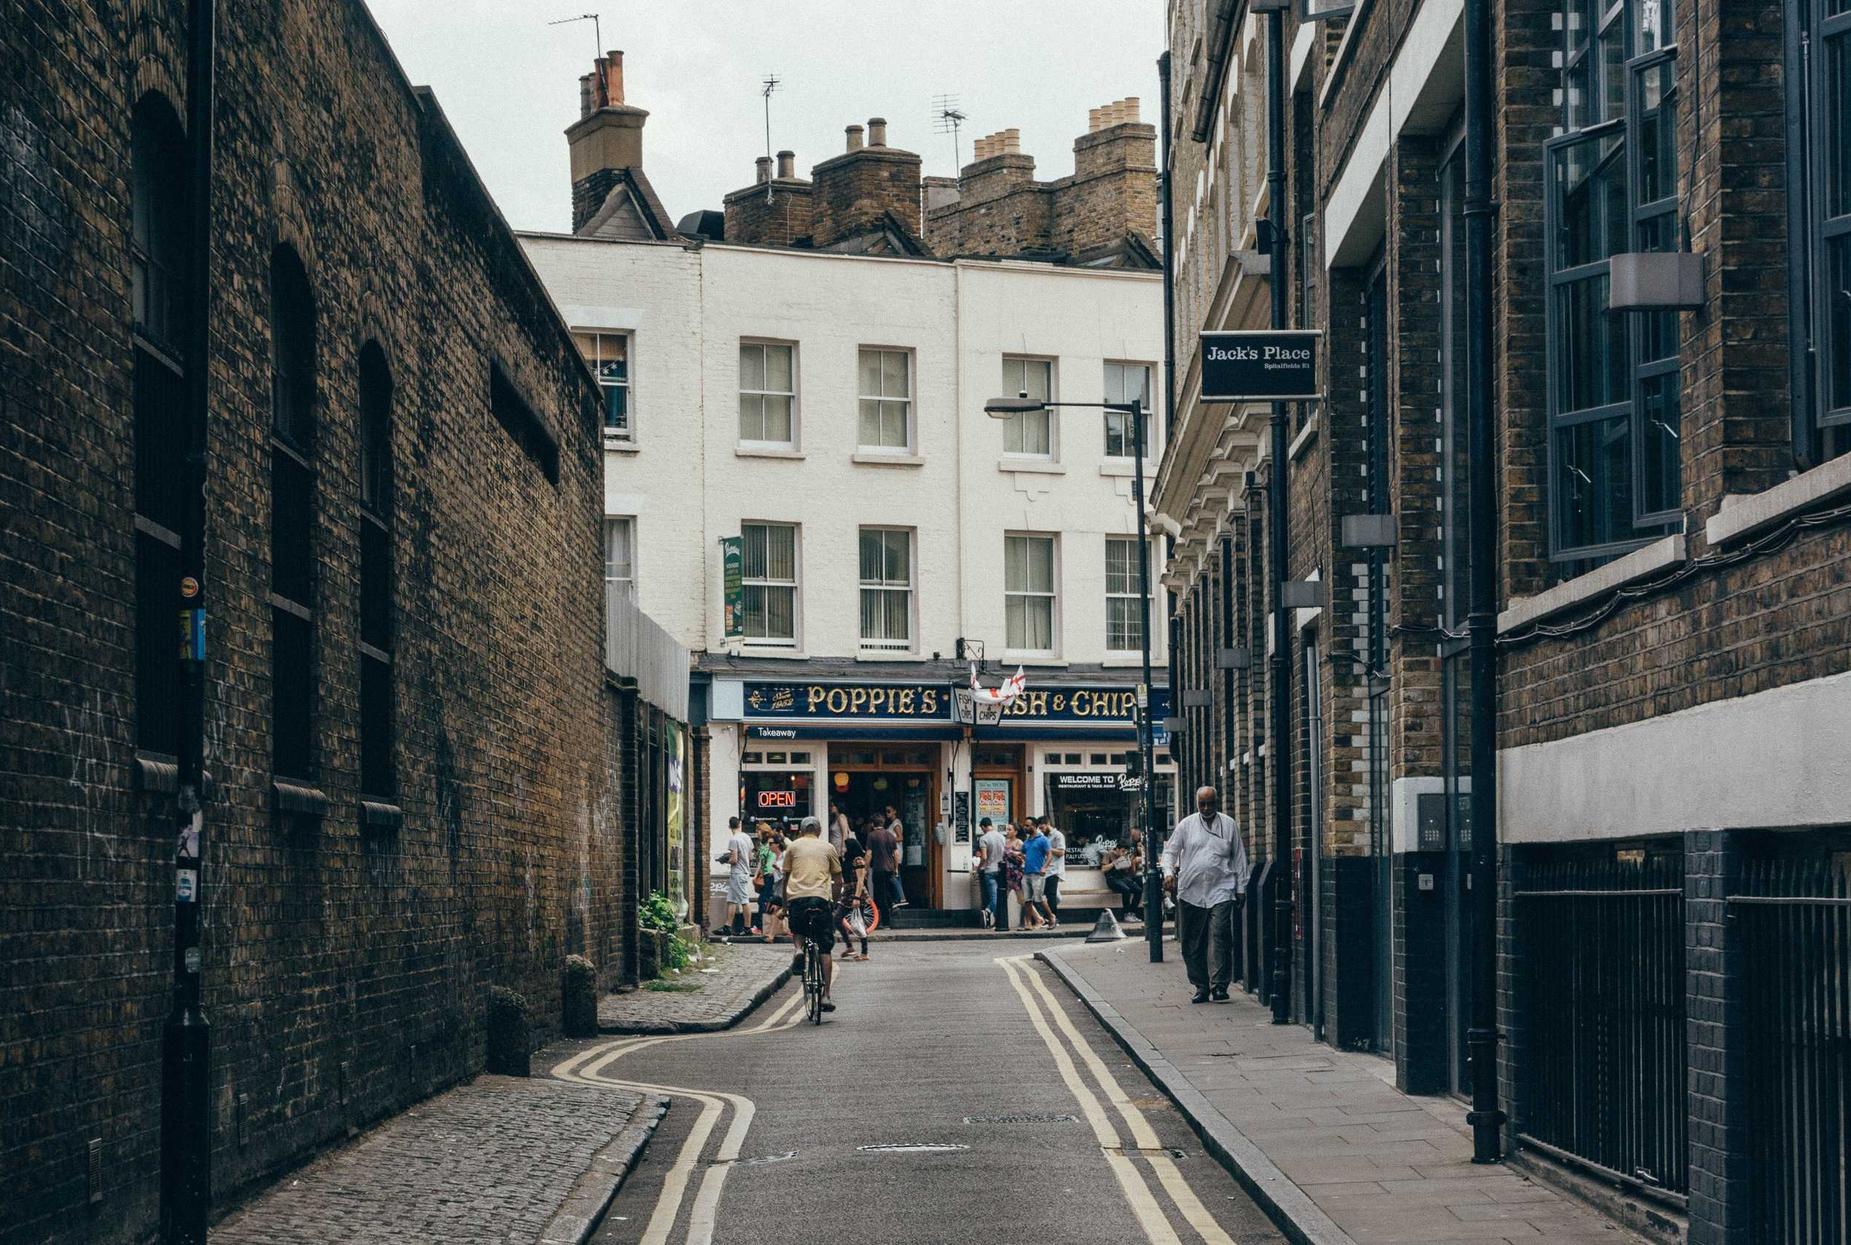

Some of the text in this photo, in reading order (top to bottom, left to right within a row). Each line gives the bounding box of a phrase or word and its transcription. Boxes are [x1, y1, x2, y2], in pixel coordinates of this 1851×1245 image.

[1207, 346, 1311, 361] Jack's Place
[1264, 362, 1300, 370] Spitalfields
[807, 686, 937, 714] POPPIE'S
[958, 693, 972, 705] FISH
[1053, 694, 1066, 711] &
[1070, 690, 1137, 717] CHIP
[979, 711, 997, 720] CHIPS
[758, 727, 797, 739] Takeaway
[760, 792, 794, 806] OPEN
